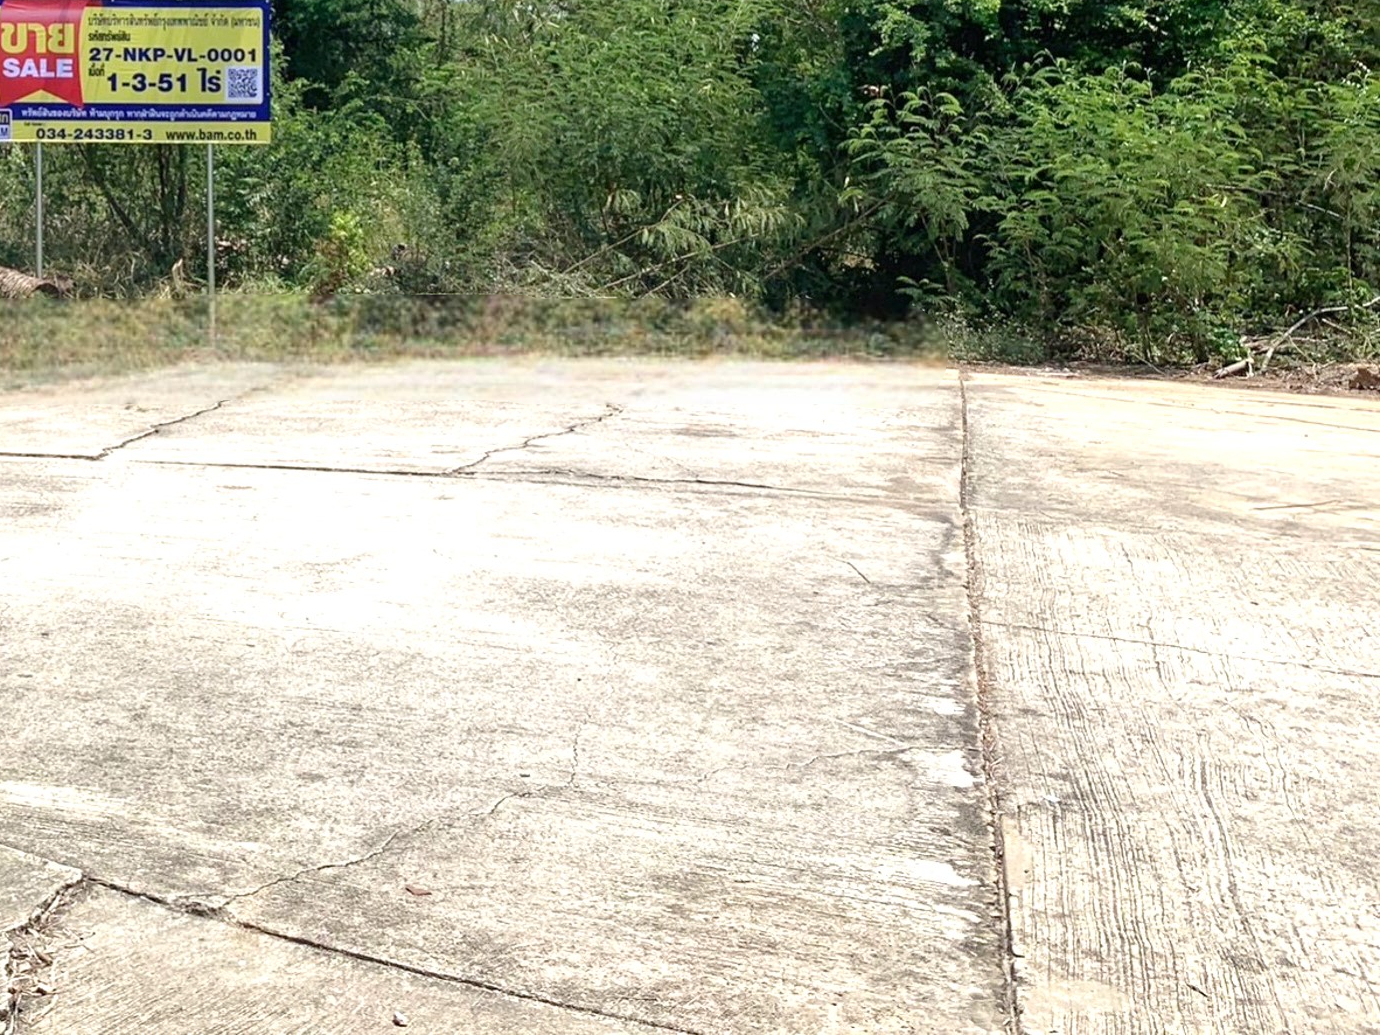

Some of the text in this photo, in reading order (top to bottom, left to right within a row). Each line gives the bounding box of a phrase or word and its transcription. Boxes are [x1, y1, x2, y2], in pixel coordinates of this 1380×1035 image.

[0, 22, 75, 54] ขาย
[88, 47, 256, 62] 27-NKP-VL-0001
[2, 58, 74, 79] SALE
[107, 68, 221, 93] 1-3-51 ไร่
[36, 128, 153, 140] 034-243381-3
[165, 128, 257, 141] www.bam.co.th
